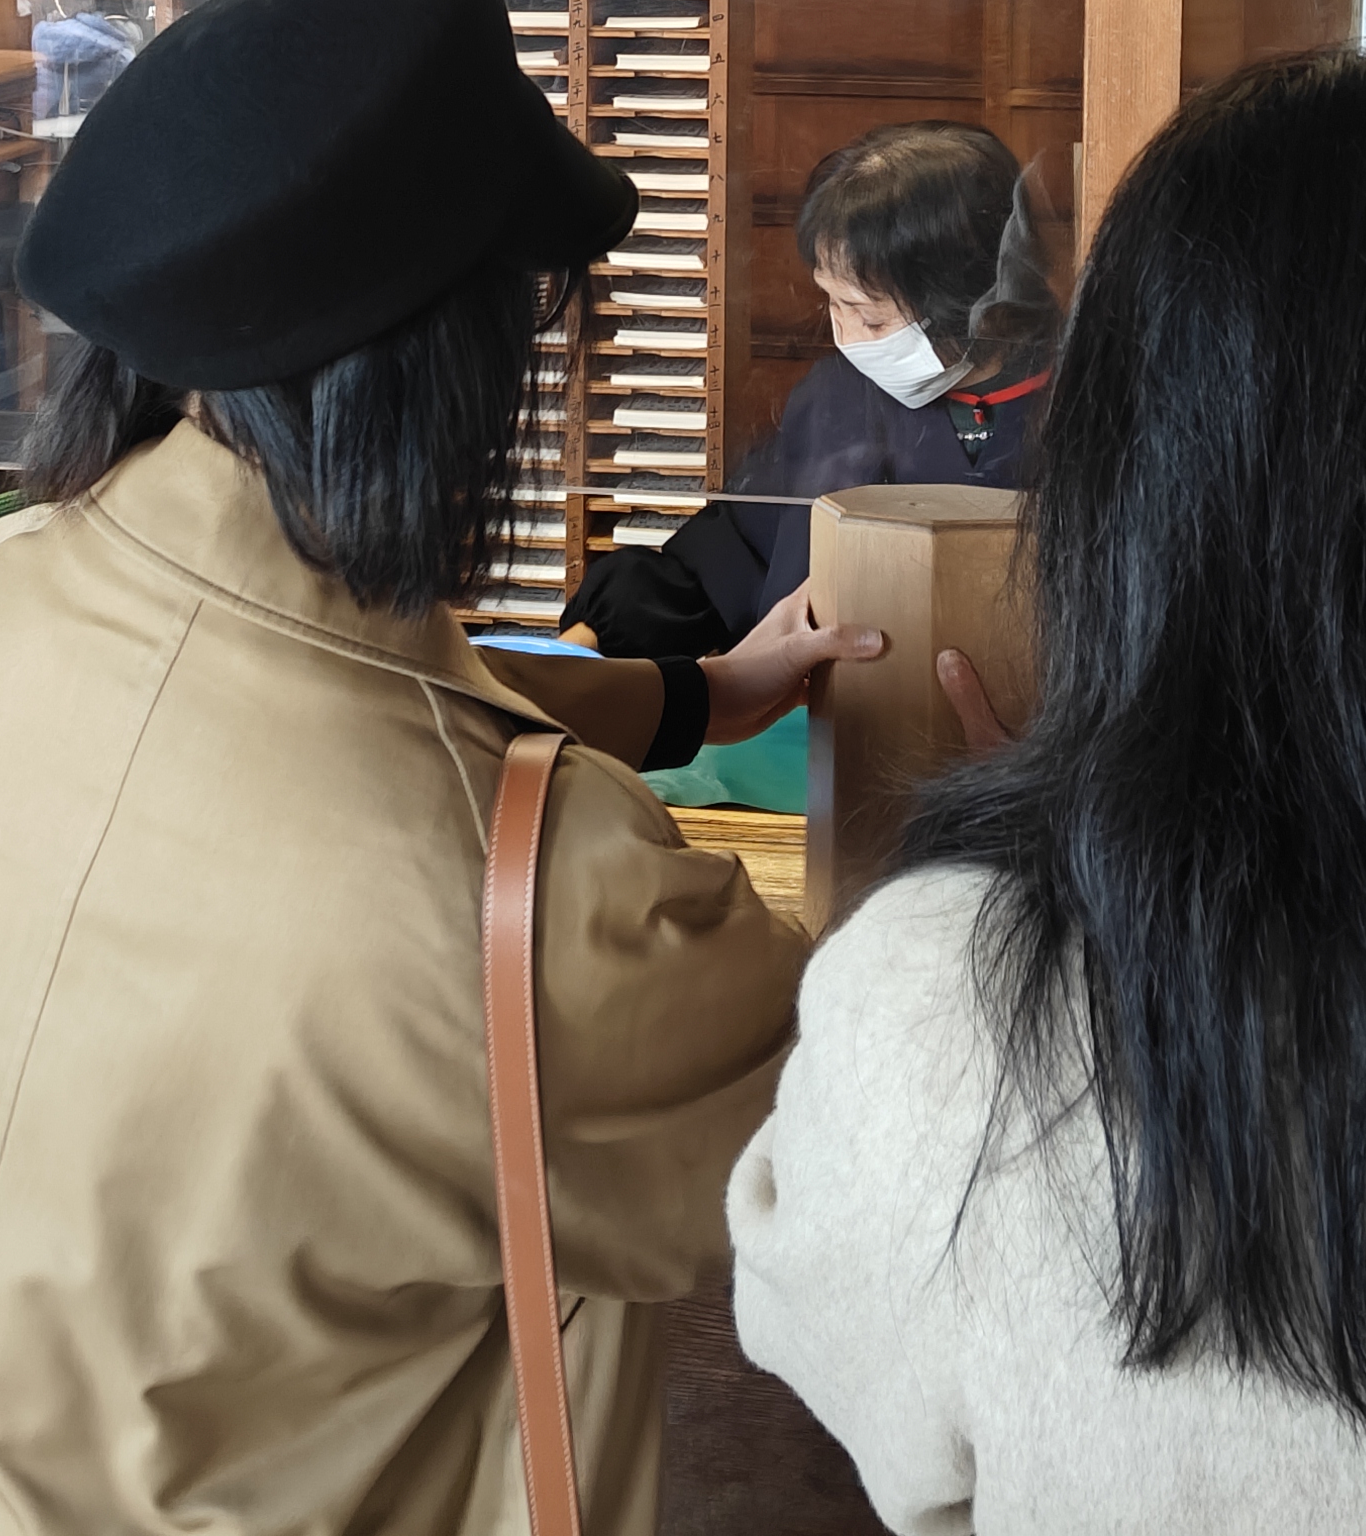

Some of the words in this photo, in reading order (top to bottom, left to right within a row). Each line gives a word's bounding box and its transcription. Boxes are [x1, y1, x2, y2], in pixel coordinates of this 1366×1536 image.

[572, 41, 584, 67] 三十
[711, 52, 725, 64] 五
[570, 78, 584, 107] 三十一
[711, 92, 725, 106] 六
[712, 132, 722, 143] 七
[711, 174, 724, 182] 八
[712, 213, 724, 224] 九
[712, 249, 722, 263] 十
[710, 286, 722, 307] 十一
[709, 324, 722, 349] 十二
[709, 365, 722, 392] 十三
[708, 406, 721, 430] 十四
